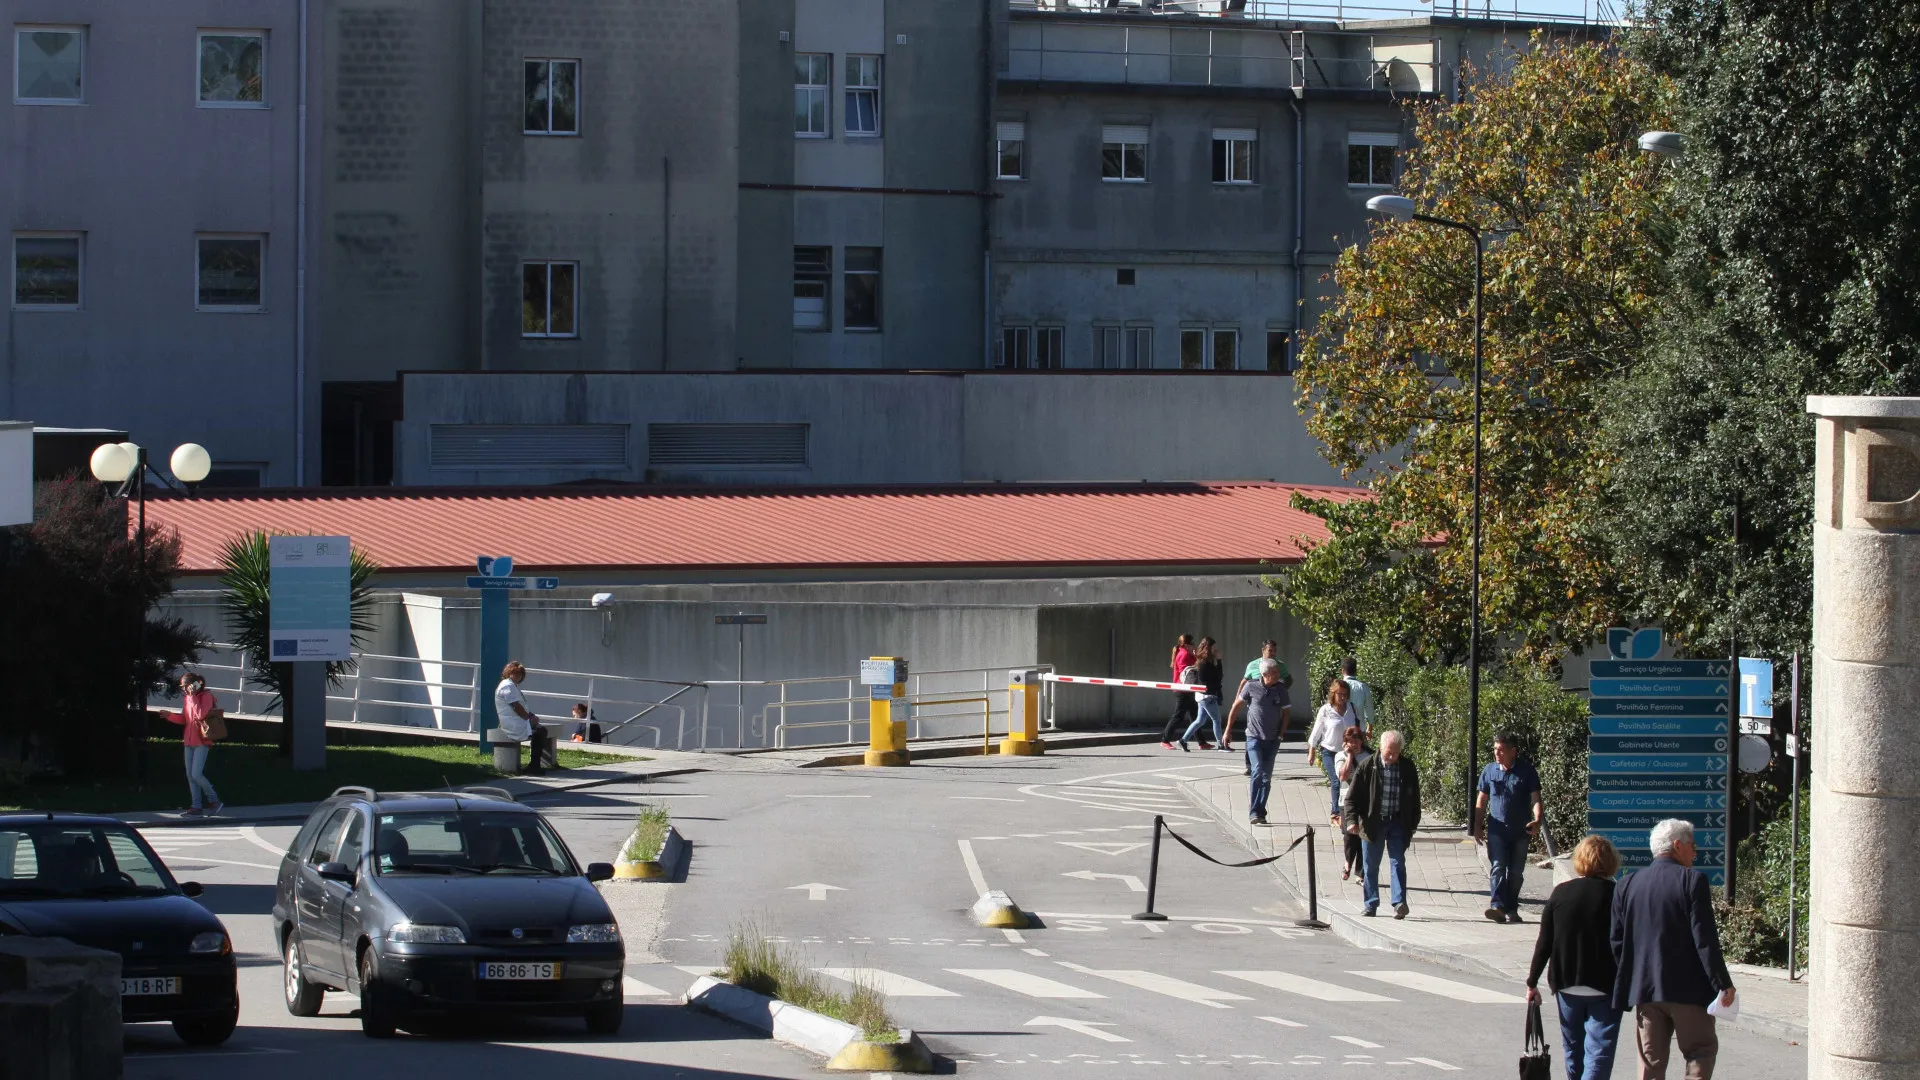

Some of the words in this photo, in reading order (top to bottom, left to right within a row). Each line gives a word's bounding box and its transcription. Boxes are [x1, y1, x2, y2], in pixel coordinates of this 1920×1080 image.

[1619, 665, 1647, 675] Serviço
[1649, 664, 1682, 675] Urgência
[1619, 684, 1652, 692] Pavilhão
[1653, 684, 1681, 692] Central
[1616, 703, 1649, 711] Pavilhão
[1650, 703, 1684, 711] Feminino
[1618, 722, 1651, 730] Pavilhão
[1652, 721, 1681, 730] Satélite
[1747, 721, 1758, 731] 50
[1618, 741, 1652, 749] Gabinete
[1654, 741, 1680, 749] Utente
[1609, 760, 1646, 768] Cafetaria
[1652, 760, 1688, 769] Quiosque
[1596, 779, 1628, 787] Pavilhão
[1630, 779, 1701, 788] Imunohemoterapia
[1602, 798, 1629, 806] Capela
[1656, 797, 1695, 805] Mortuária
[1617, 816, 1650, 824] Pavilhão
[1611, 835, 1645, 843] Pavilhão
[1055, 919, 1316, 940] STOP
[661, 938, 1012, 946] AUORIZADAS
[487, 964, 552, 978] 66-86-TS
